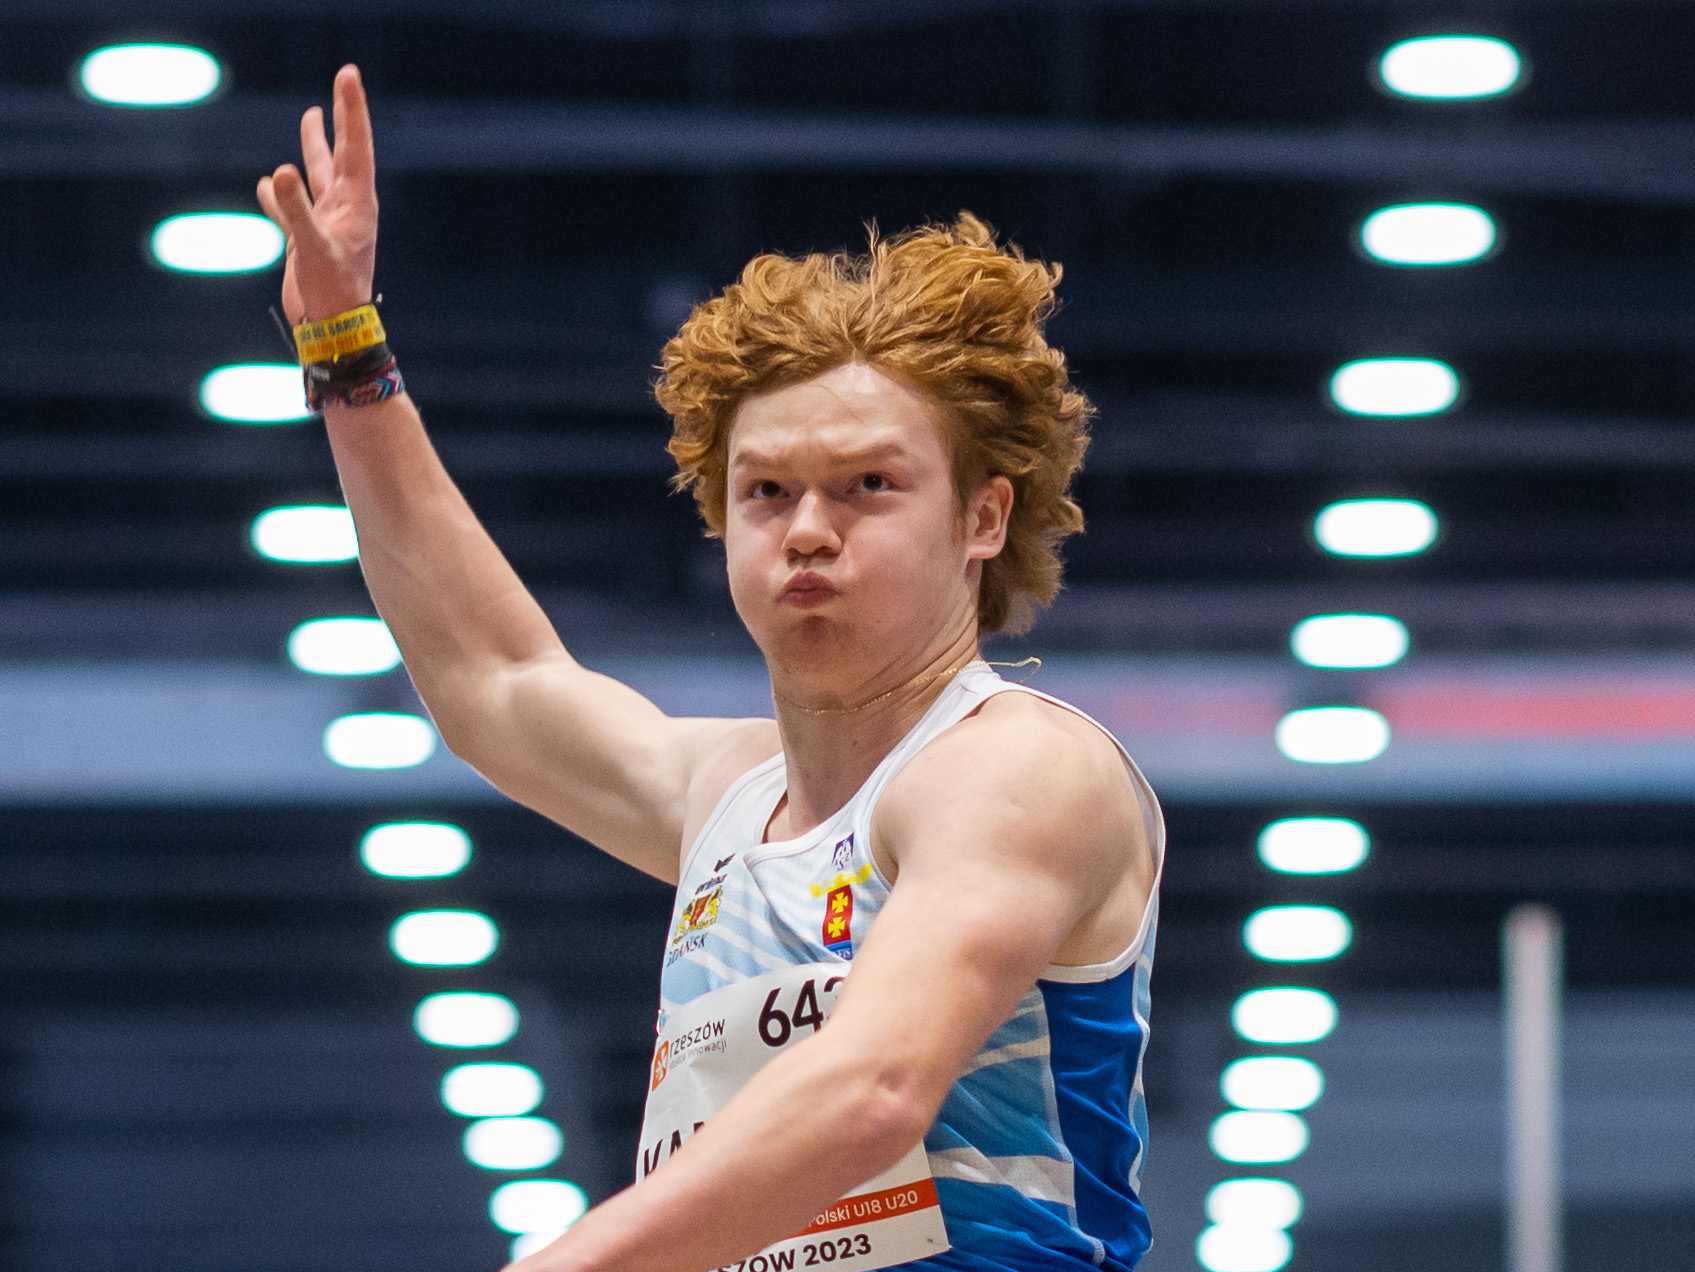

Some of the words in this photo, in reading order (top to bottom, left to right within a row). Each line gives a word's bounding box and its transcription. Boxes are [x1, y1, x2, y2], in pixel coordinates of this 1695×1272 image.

[670, 1018, 726, 1059] rzeszów
[808, 1204, 850, 1228] olski
[853, 1199, 882, 1217] U18
[885, 1190, 919, 1210] U20
[802, 1233, 872, 1267] 2023
